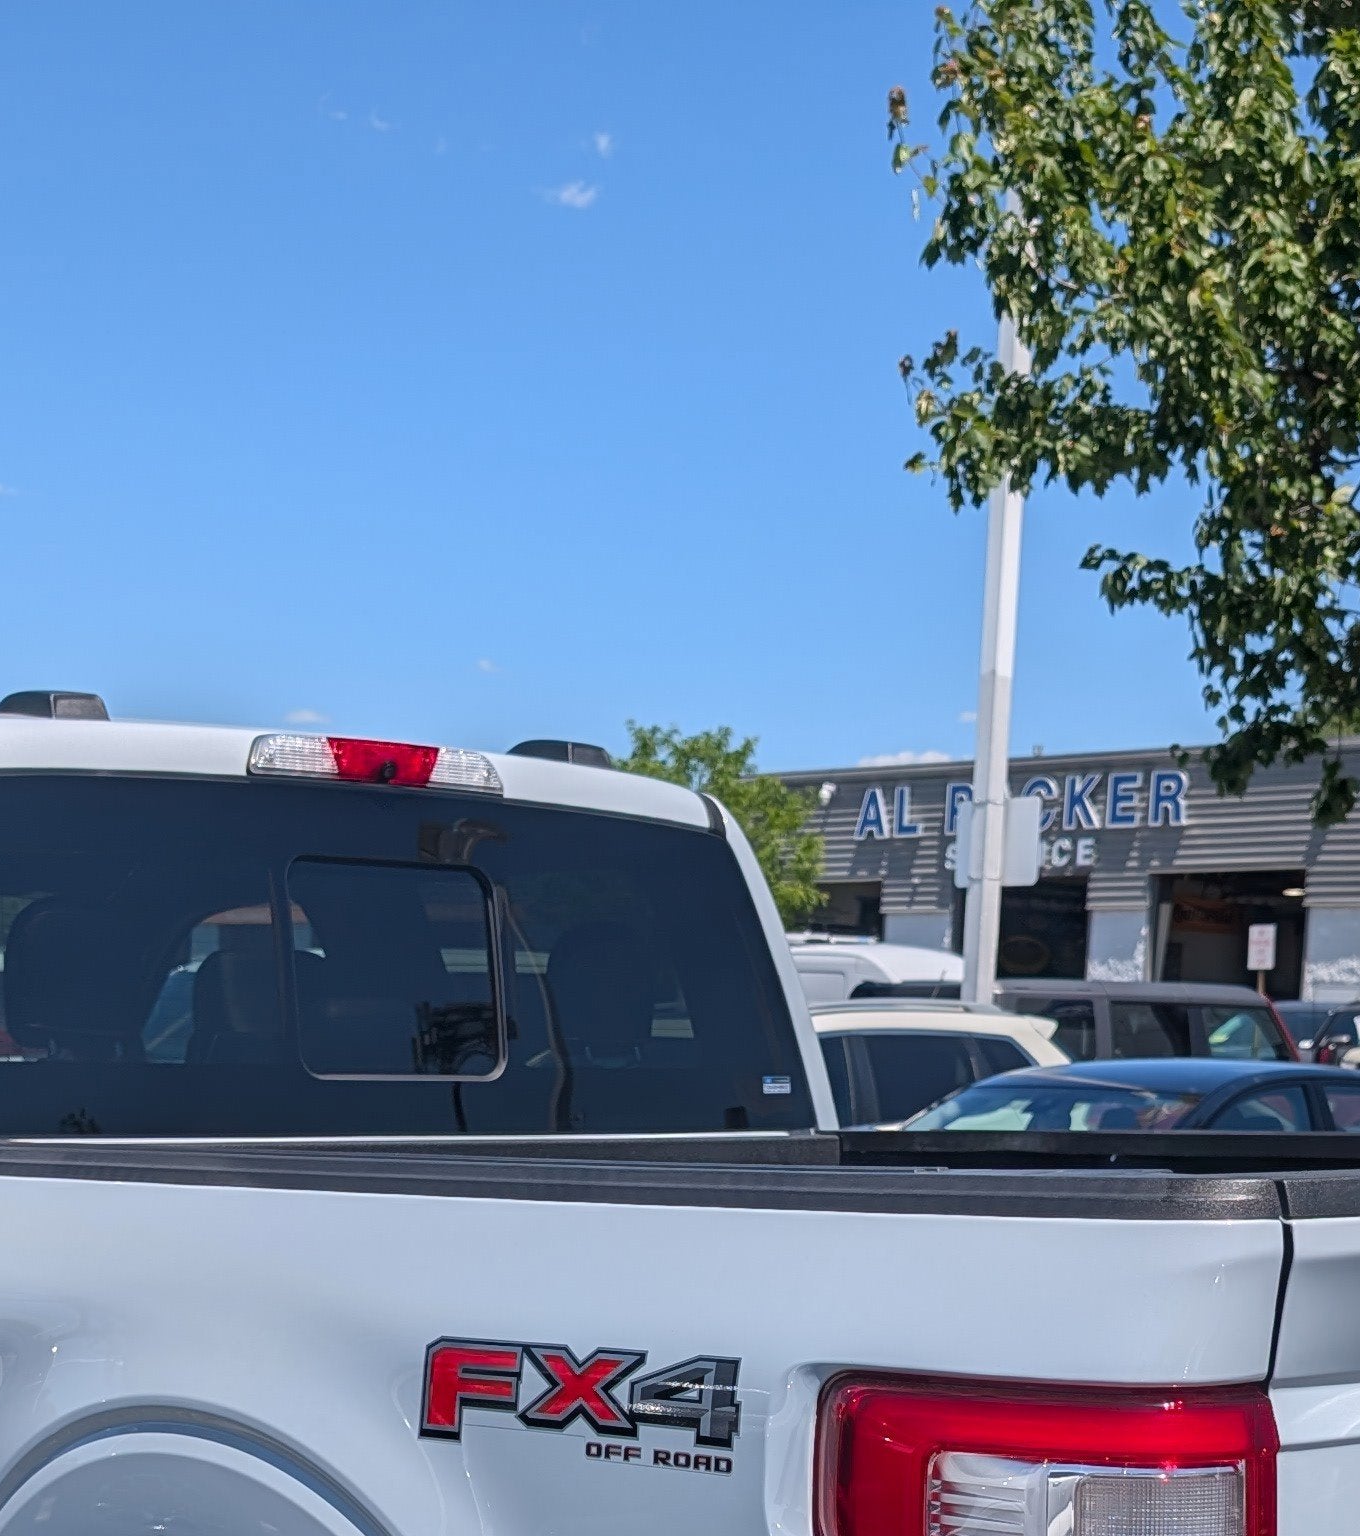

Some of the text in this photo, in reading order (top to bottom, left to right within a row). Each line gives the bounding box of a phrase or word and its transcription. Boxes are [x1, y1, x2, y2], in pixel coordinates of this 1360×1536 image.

[854, 769, 1189, 841] AL PCKER
[418, 1336, 743, 1451] FX4
[586, 1440, 733, 1475] OFF ROAD
